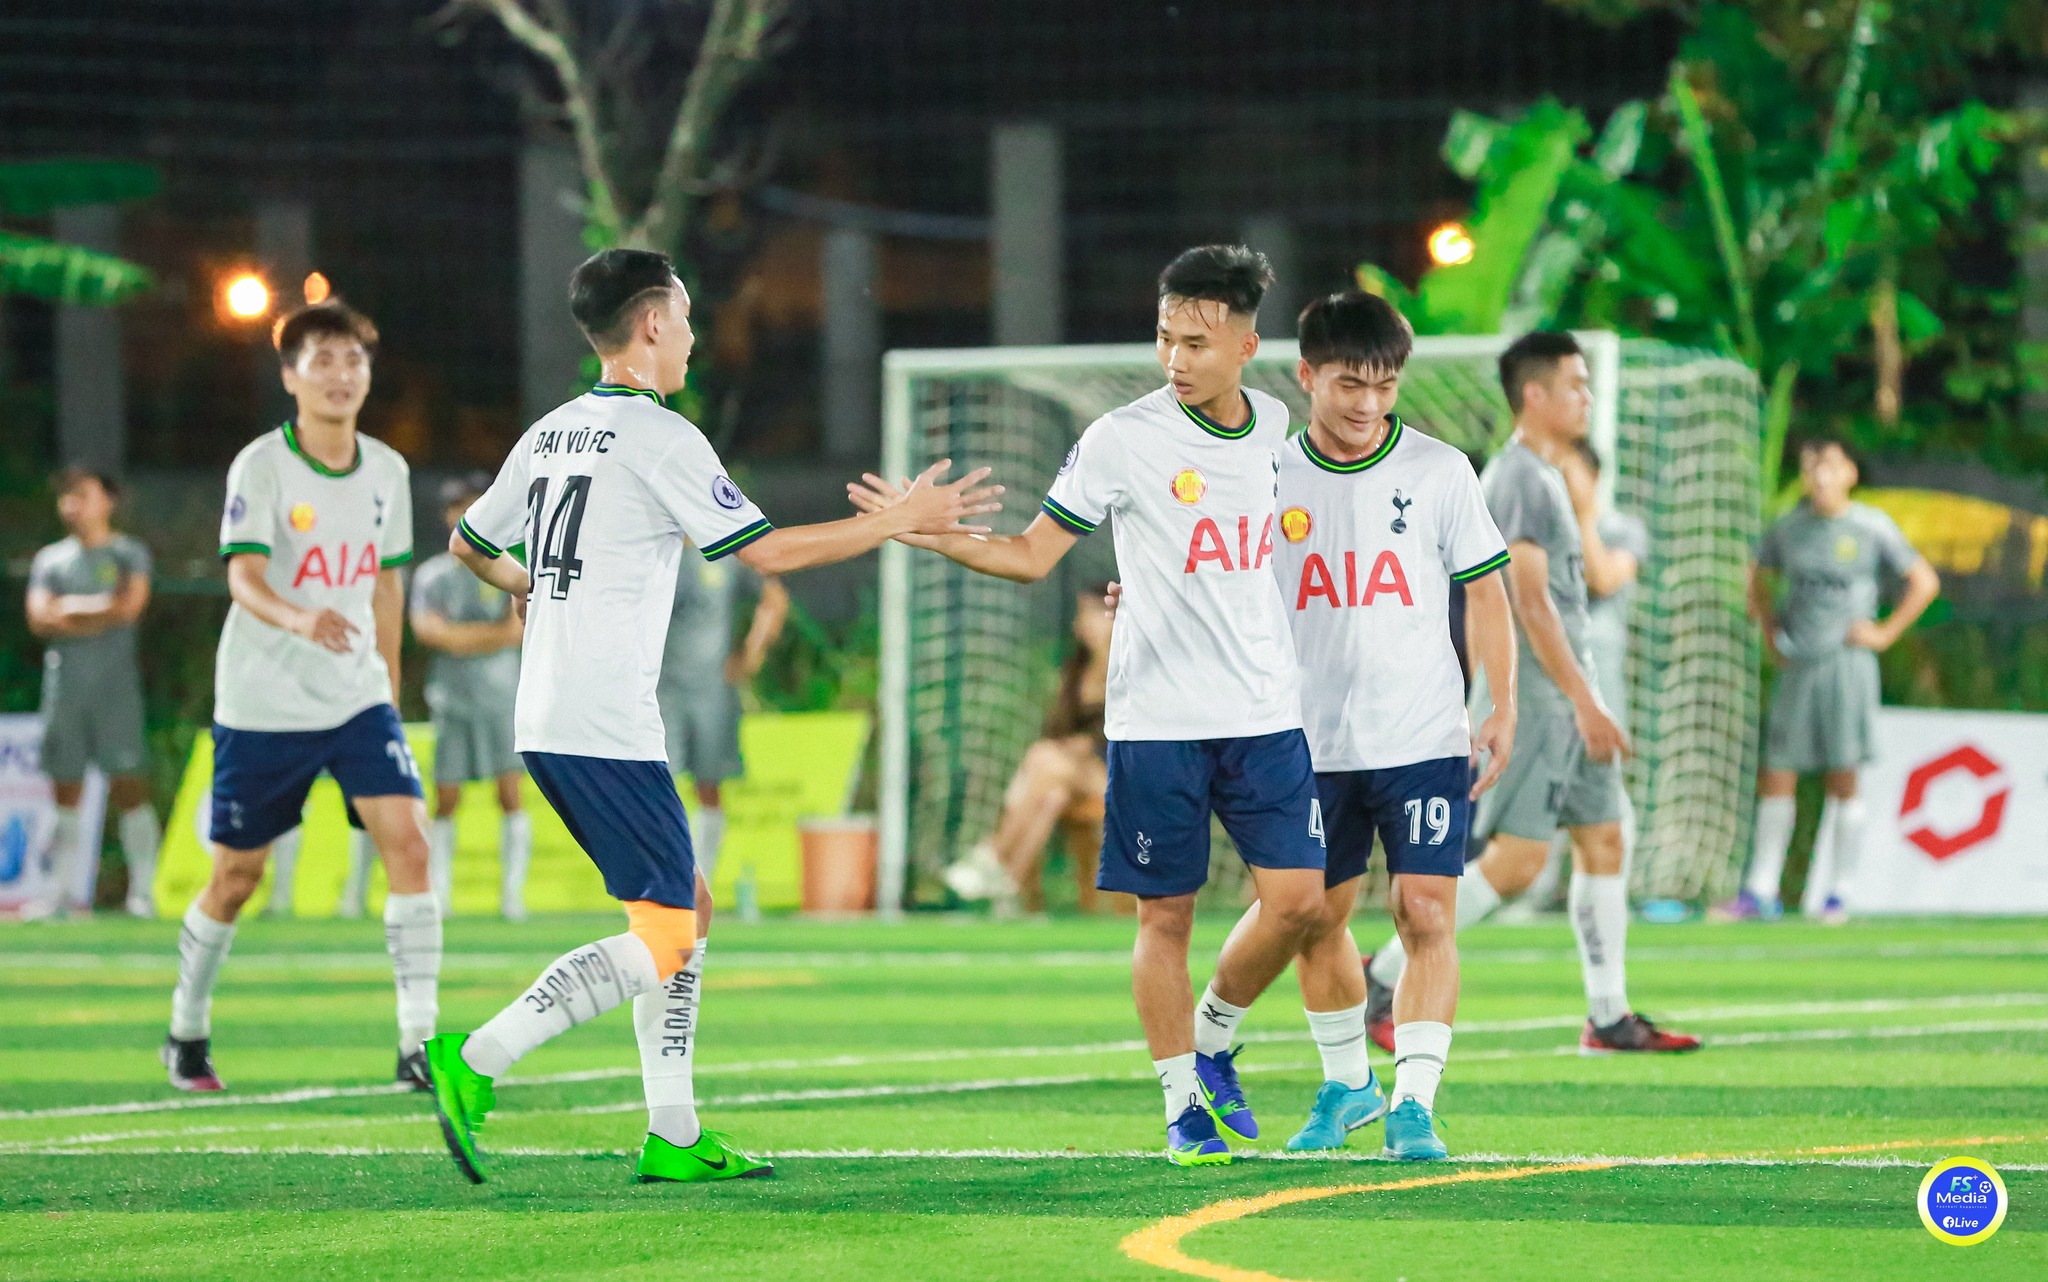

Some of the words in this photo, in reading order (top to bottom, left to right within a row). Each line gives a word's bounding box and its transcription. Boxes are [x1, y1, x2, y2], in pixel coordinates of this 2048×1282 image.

[567, 427, 590, 454] VŨ
[588, 430, 616, 454] FC
[525, 475, 592, 600] 14
[292, 541, 379, 588] AIA
[1296, 550, 1414, 611] AIA
[1405, 796, 1451, 846] 19
[525, 987, 555, 1014] FC
[661, 1035, 687, 1057] FC
